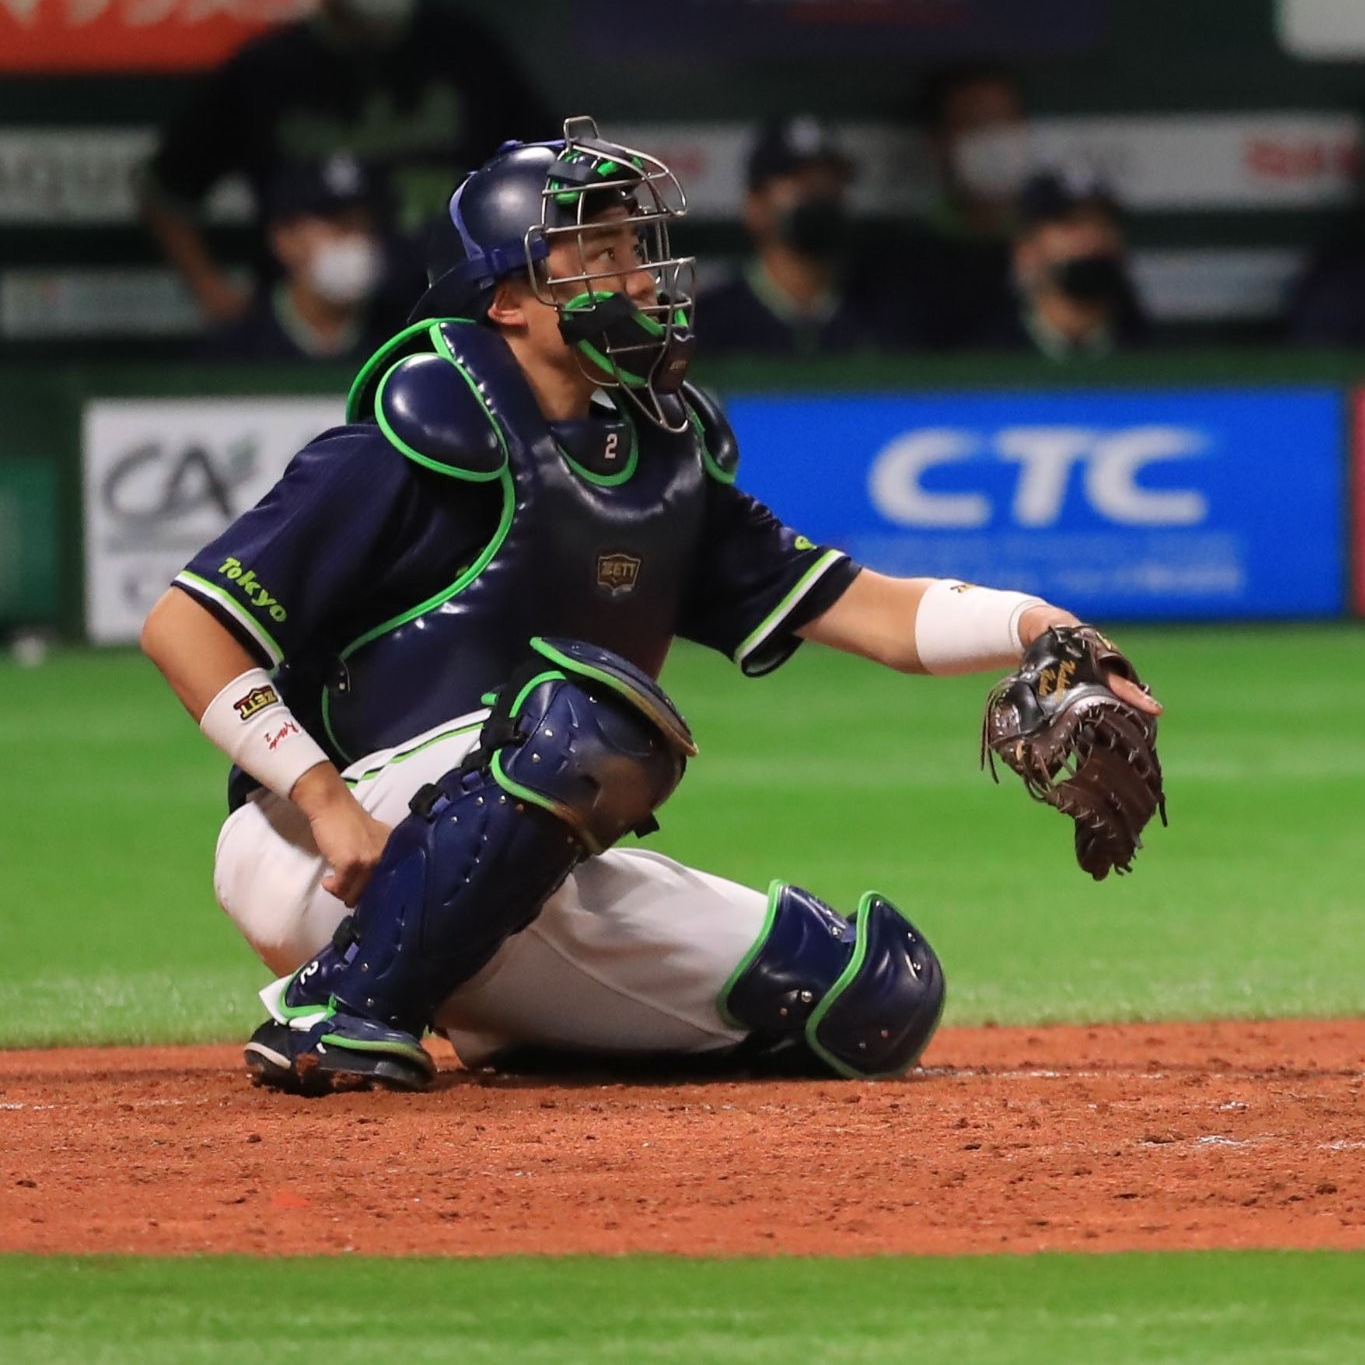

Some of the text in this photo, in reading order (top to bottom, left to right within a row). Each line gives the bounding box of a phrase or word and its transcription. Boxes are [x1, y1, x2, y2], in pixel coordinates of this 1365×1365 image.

[605, 433, 618, 459] 2
[866, 425, 1212, 530] CTC
[218, 557, 288, 622] Tokyo
[241, 690, 278, 719] ZETT
[300, 960, 319, 985] 2
